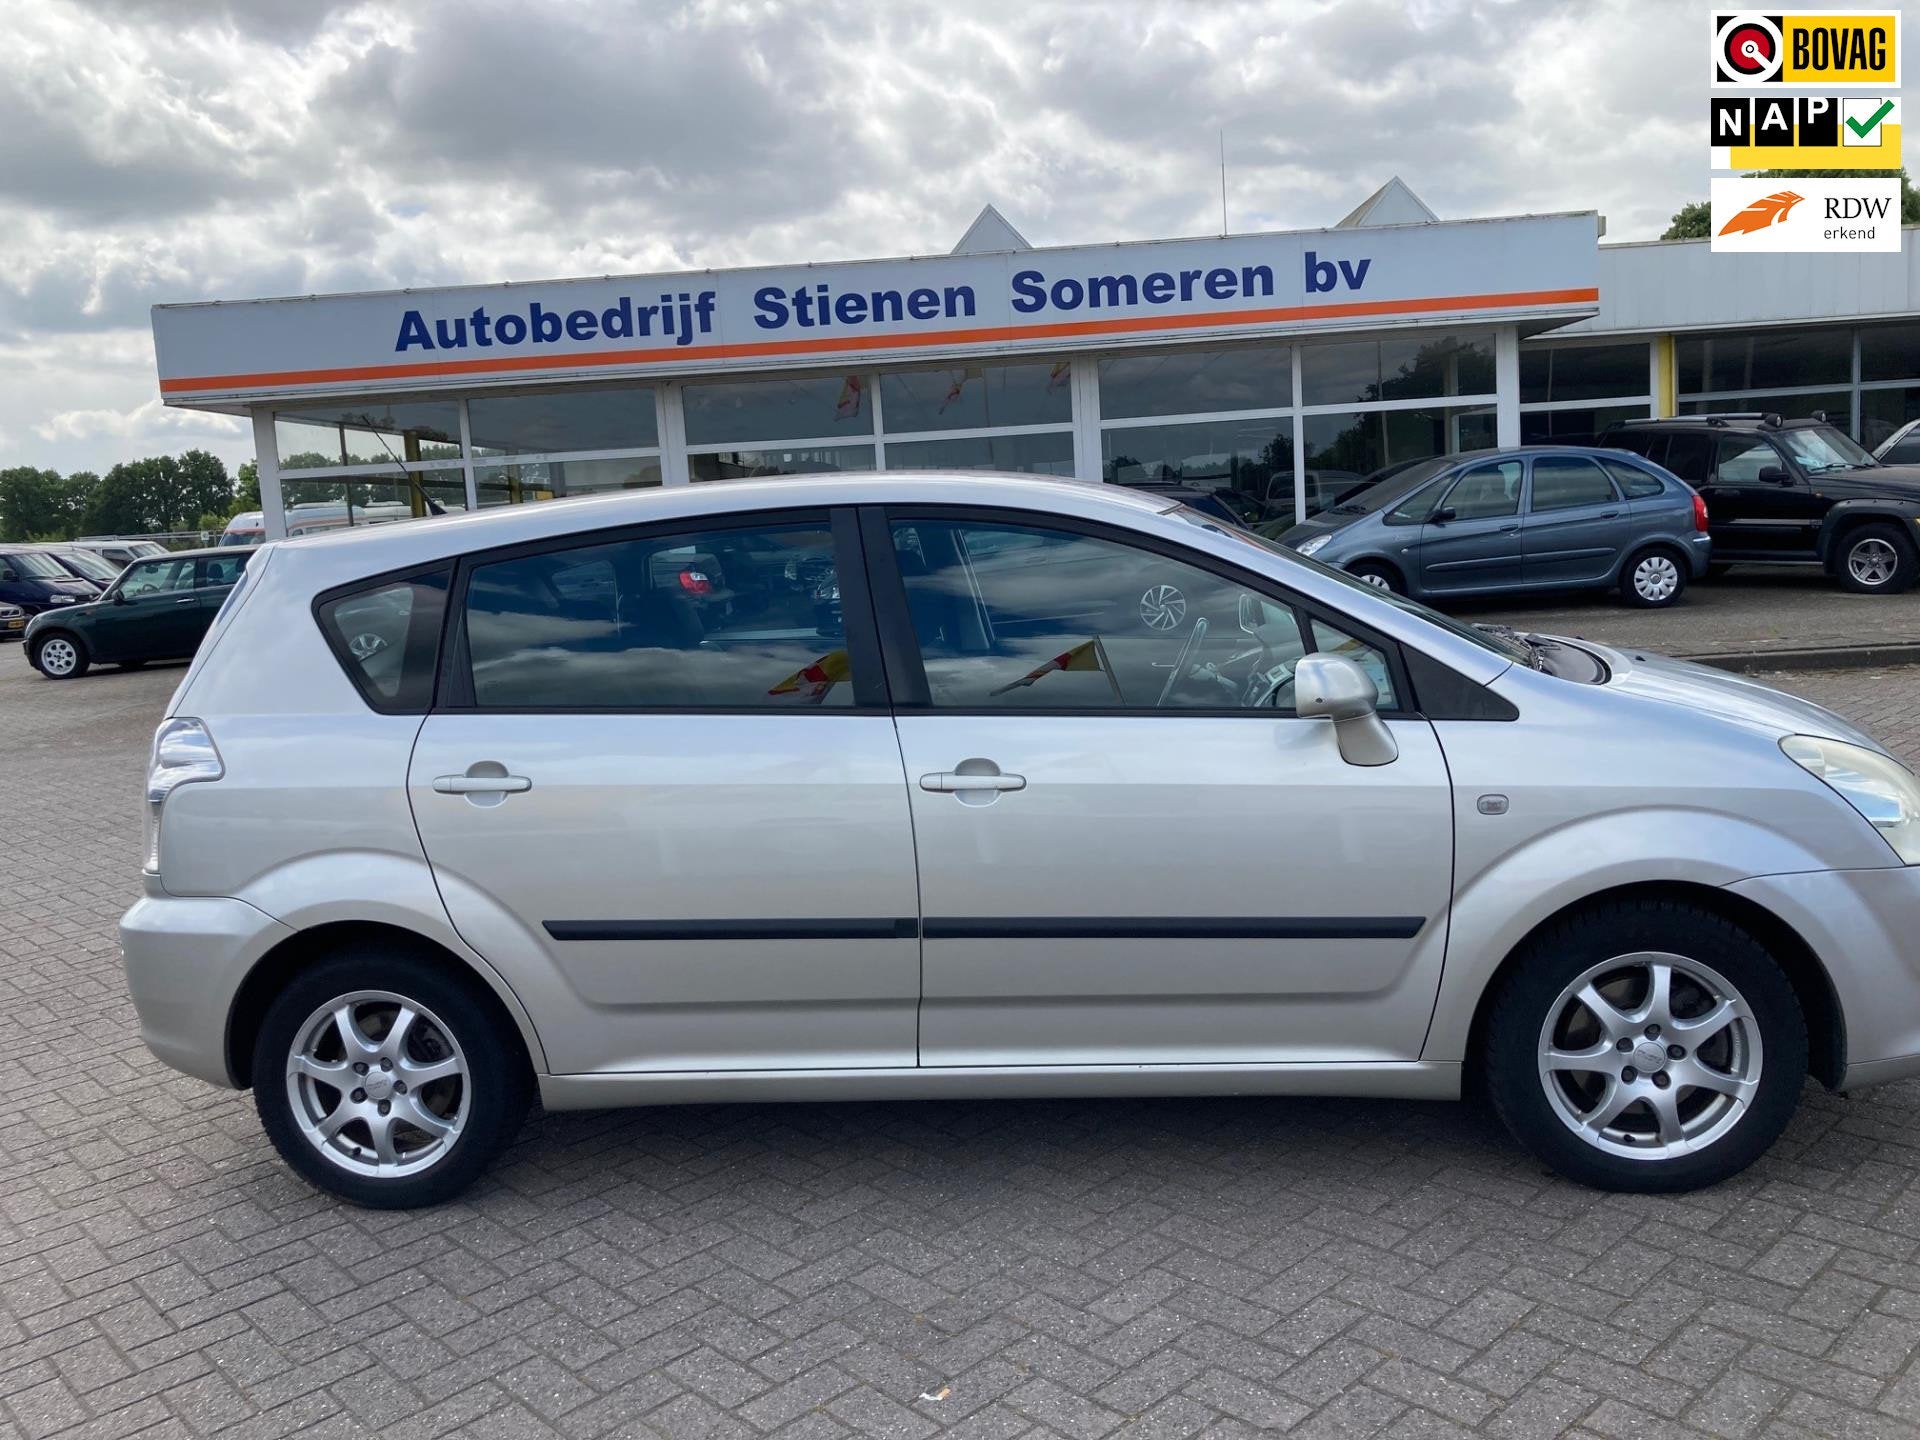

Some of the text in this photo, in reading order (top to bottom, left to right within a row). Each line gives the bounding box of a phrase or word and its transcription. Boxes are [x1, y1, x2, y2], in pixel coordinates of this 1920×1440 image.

[395, 251, 1372, 353] Autobedrijf Stienen Someren bv
